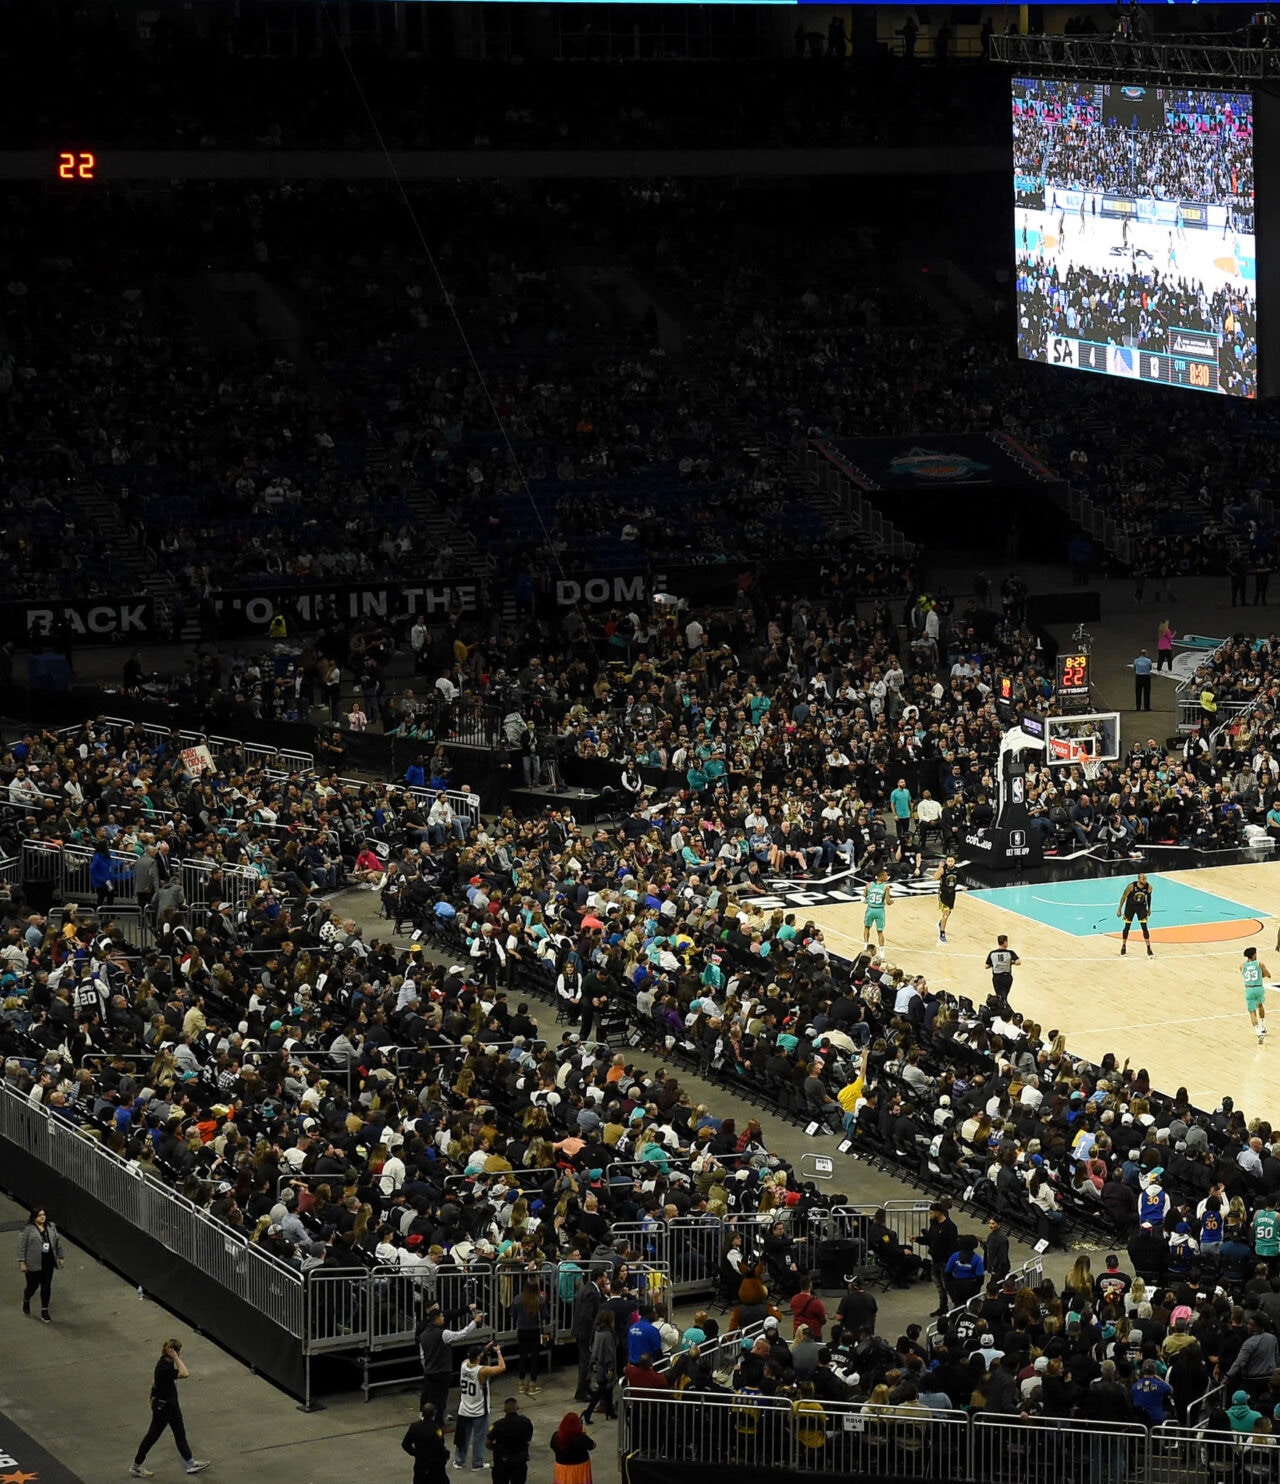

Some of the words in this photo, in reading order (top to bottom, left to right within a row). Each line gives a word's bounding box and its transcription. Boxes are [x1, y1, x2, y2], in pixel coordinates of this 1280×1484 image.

[60, 153, 94, 178] 22
[1053, 338, 1073, 364] SA
[1190, 362, 1209, 387] 8:30
[402, 586, 477, 615] THE
[1066, 656, 1086, 668] 8:29
[1063, 667, 1084, 686] 22
[869, 893, 883, 904] 35
[1244, 970, 1258, 981] 33
[80, 991, 97, 1005] 20
[1147, 1195, 1160, 1205] 30
[1205, 1221, 1218, 1230] 30
[1257, 1225, 1273, 1239] 50
[460, 1380, 476, 1397] 20
